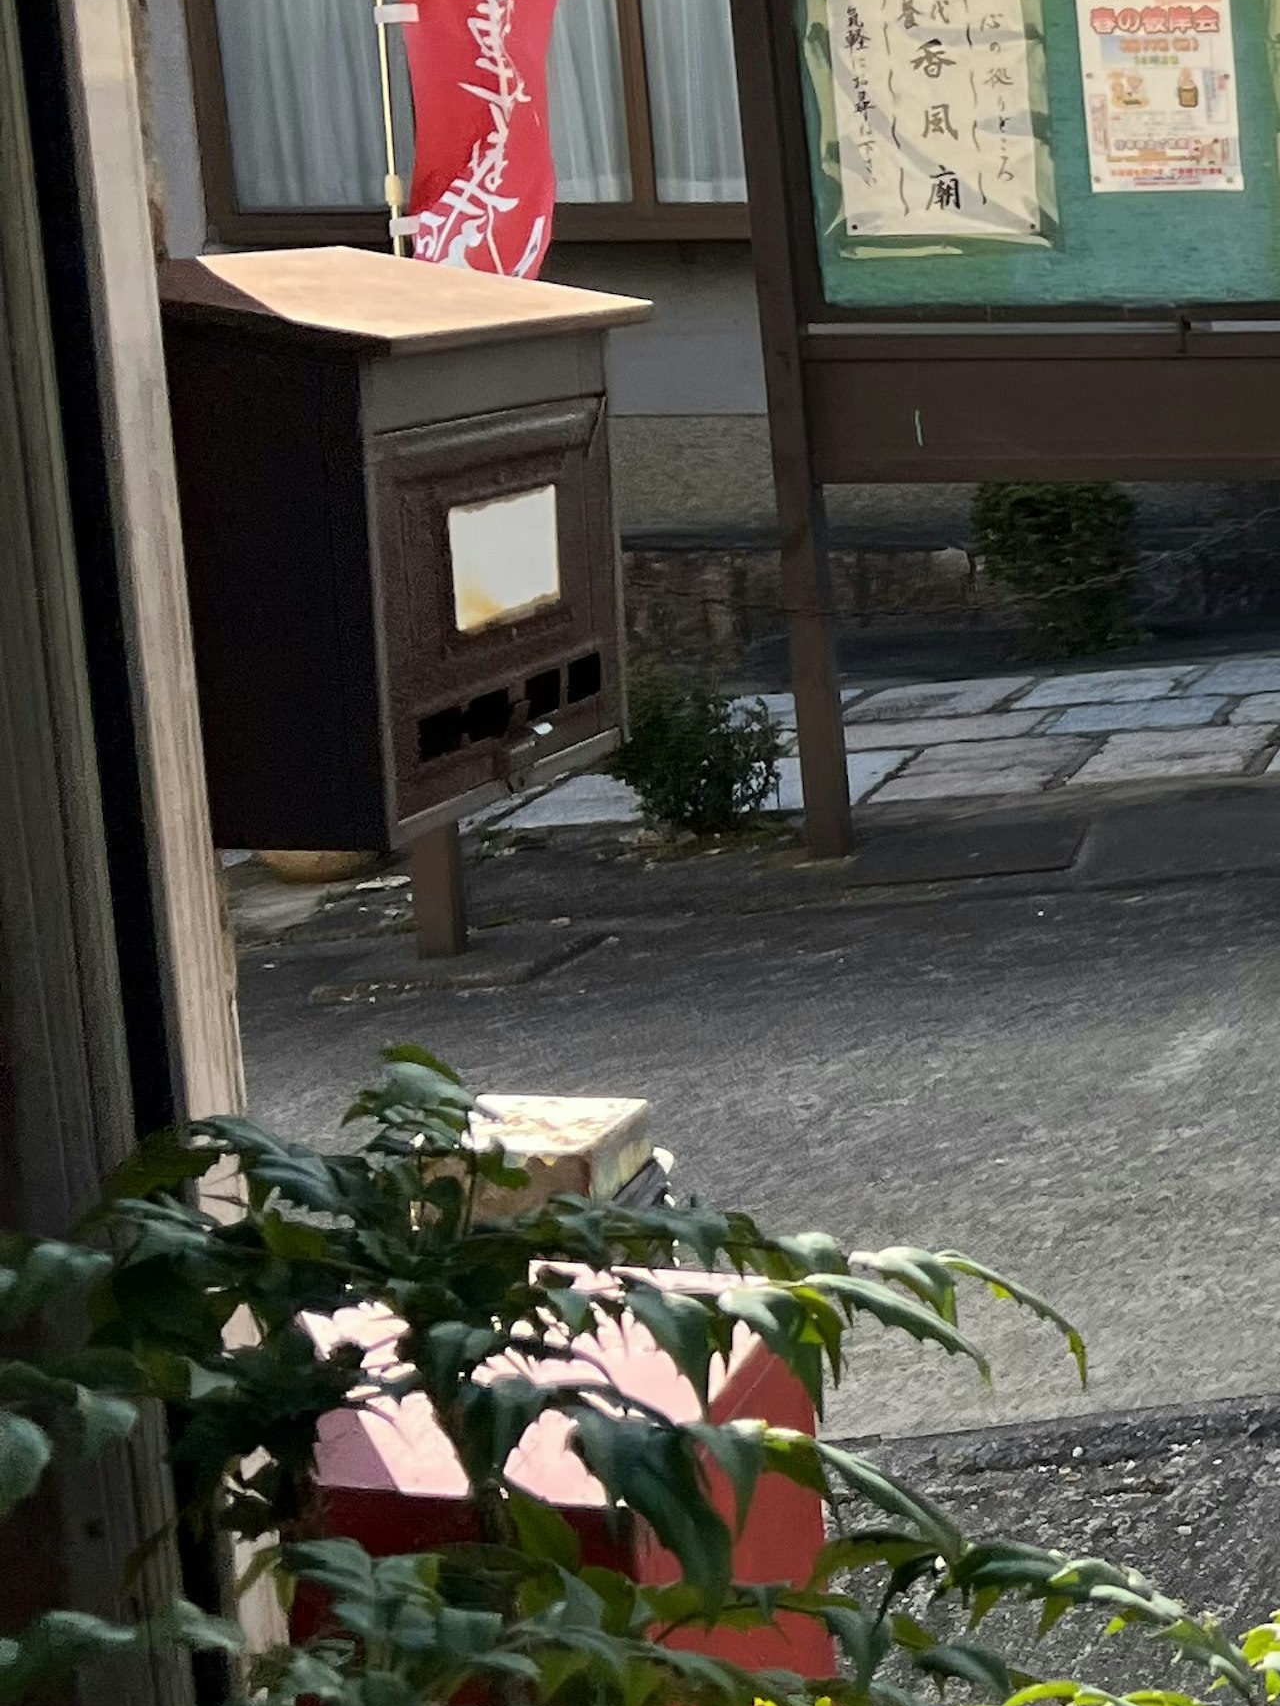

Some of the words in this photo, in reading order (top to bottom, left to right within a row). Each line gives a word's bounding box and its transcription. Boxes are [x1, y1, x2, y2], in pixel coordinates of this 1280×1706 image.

[1090, 5, 1220, 34] 春の彼岸会
